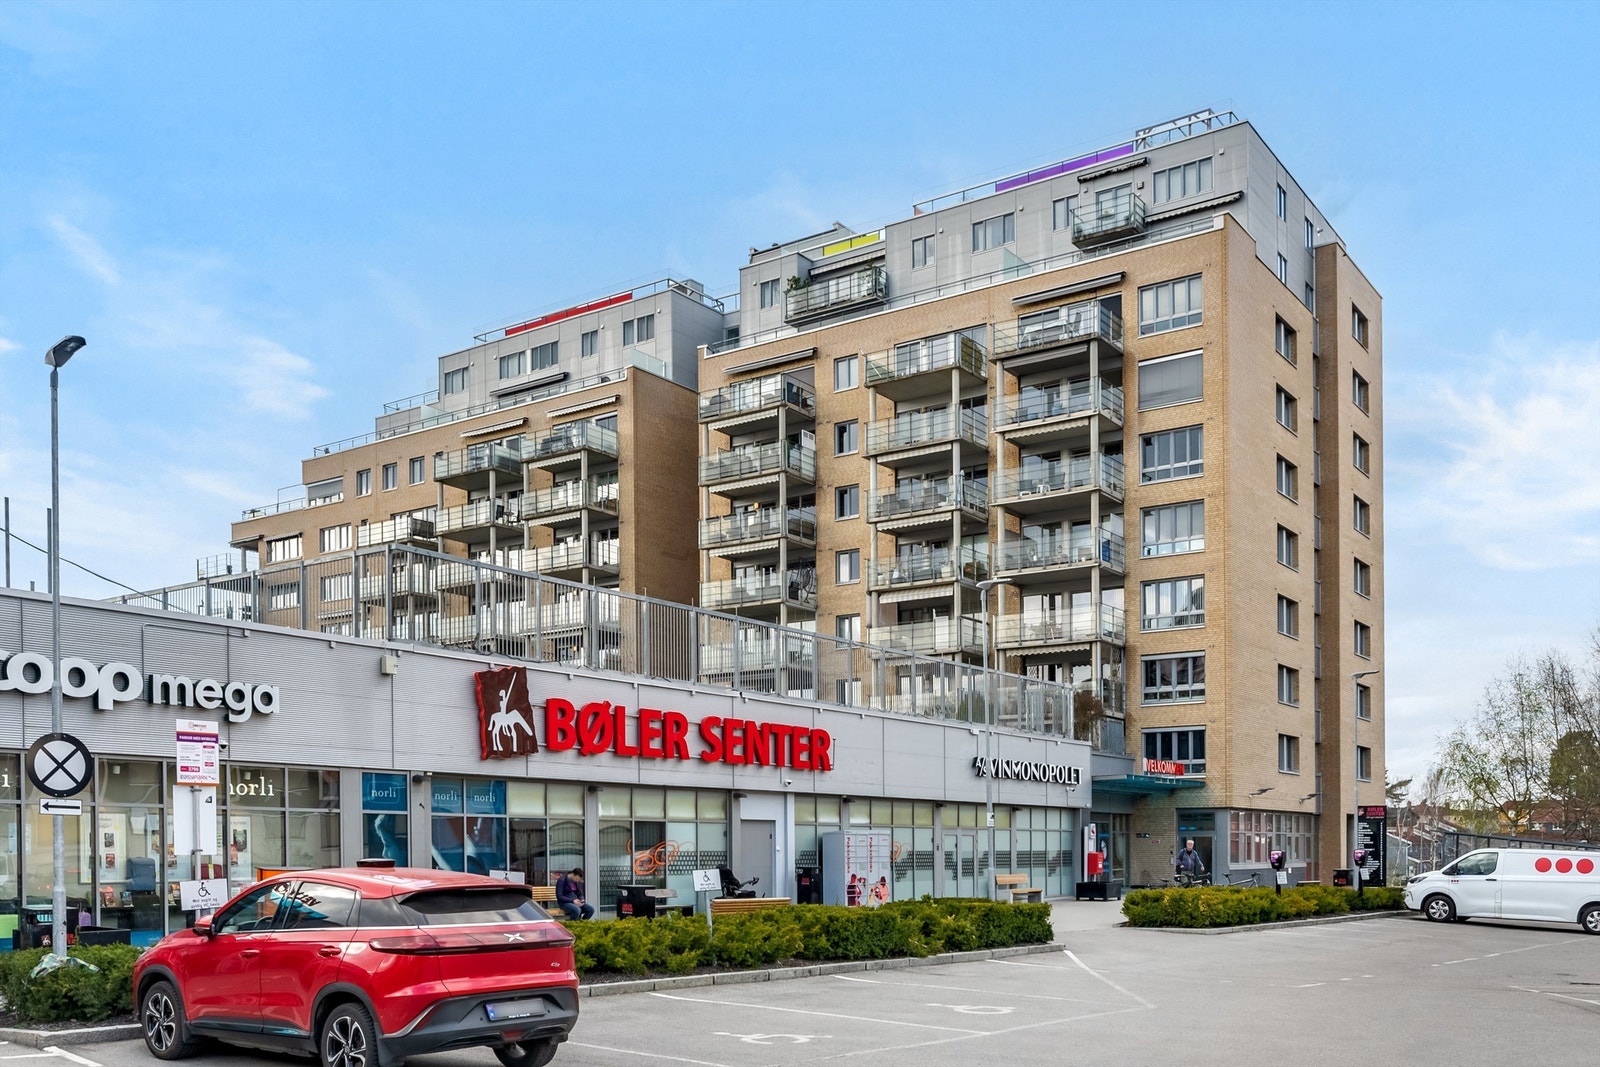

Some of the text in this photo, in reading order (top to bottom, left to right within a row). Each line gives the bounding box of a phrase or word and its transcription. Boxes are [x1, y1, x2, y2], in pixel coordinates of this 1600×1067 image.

[150, 674, 280, 722] mega
[546, 698, 833, 771] BØLER SENTER
[990, 759, 1083, 785] VINMONOPOLET
[371, 787, 397, 798] norli
[434, 791, 458, 801] norli
[474, 793, 496, 802] norli
